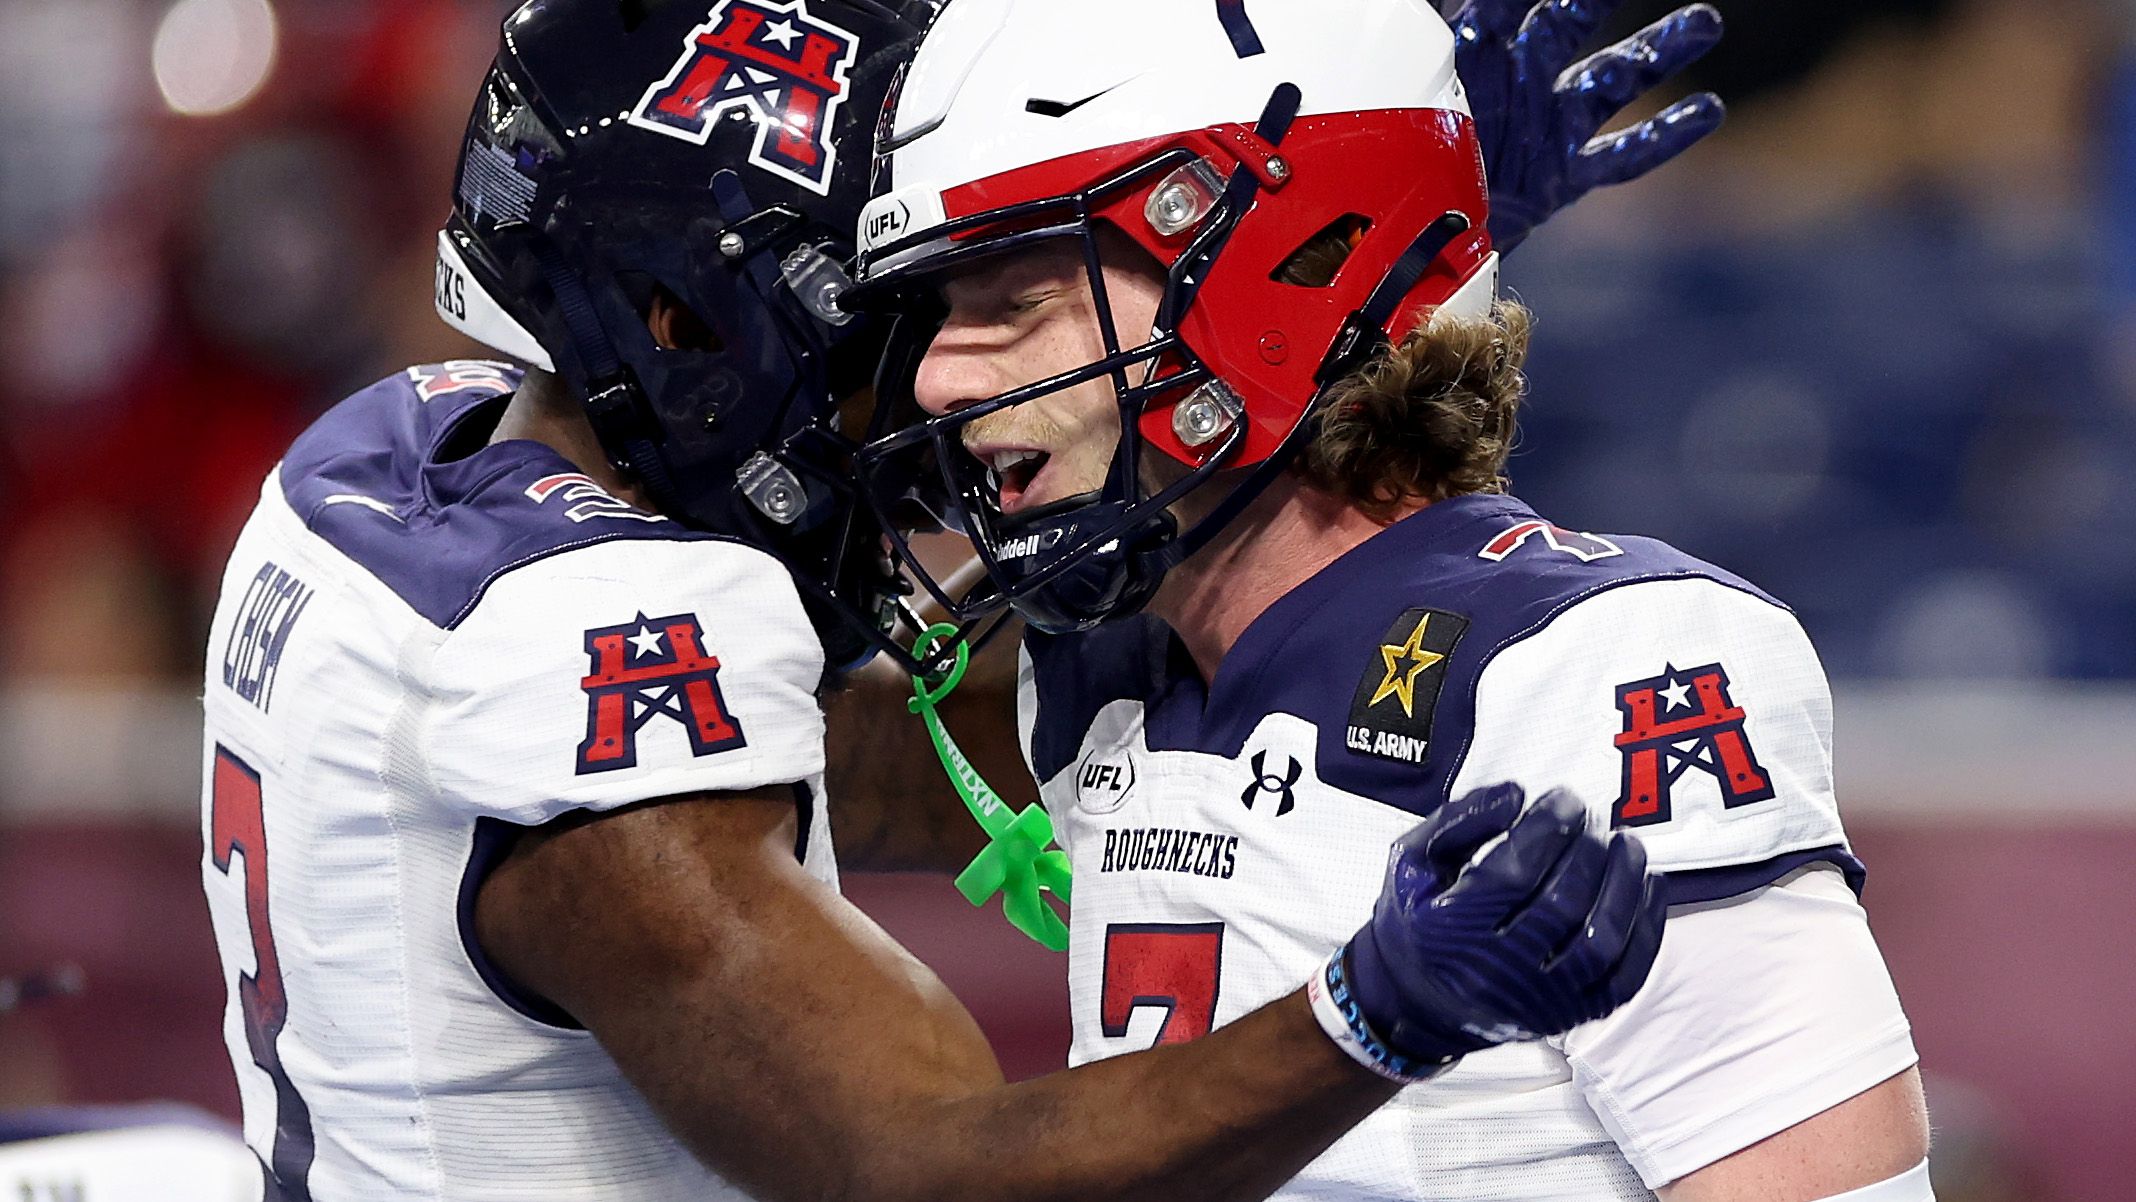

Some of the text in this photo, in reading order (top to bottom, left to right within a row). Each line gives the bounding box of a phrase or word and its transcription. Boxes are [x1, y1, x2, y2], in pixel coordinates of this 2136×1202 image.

[870, 210, 901, 240] UFL
[1477, 520, 1625, 562] 7
[1346, 725, 1428, 763] U.S. ARMY
[1082, 764, 1122, 791] UFL
[1100, 828, 1239, 880] ROUGHNECKS
[211, 740, 316, 1202] 3
[1100, 921, 1226, 1050] 7
